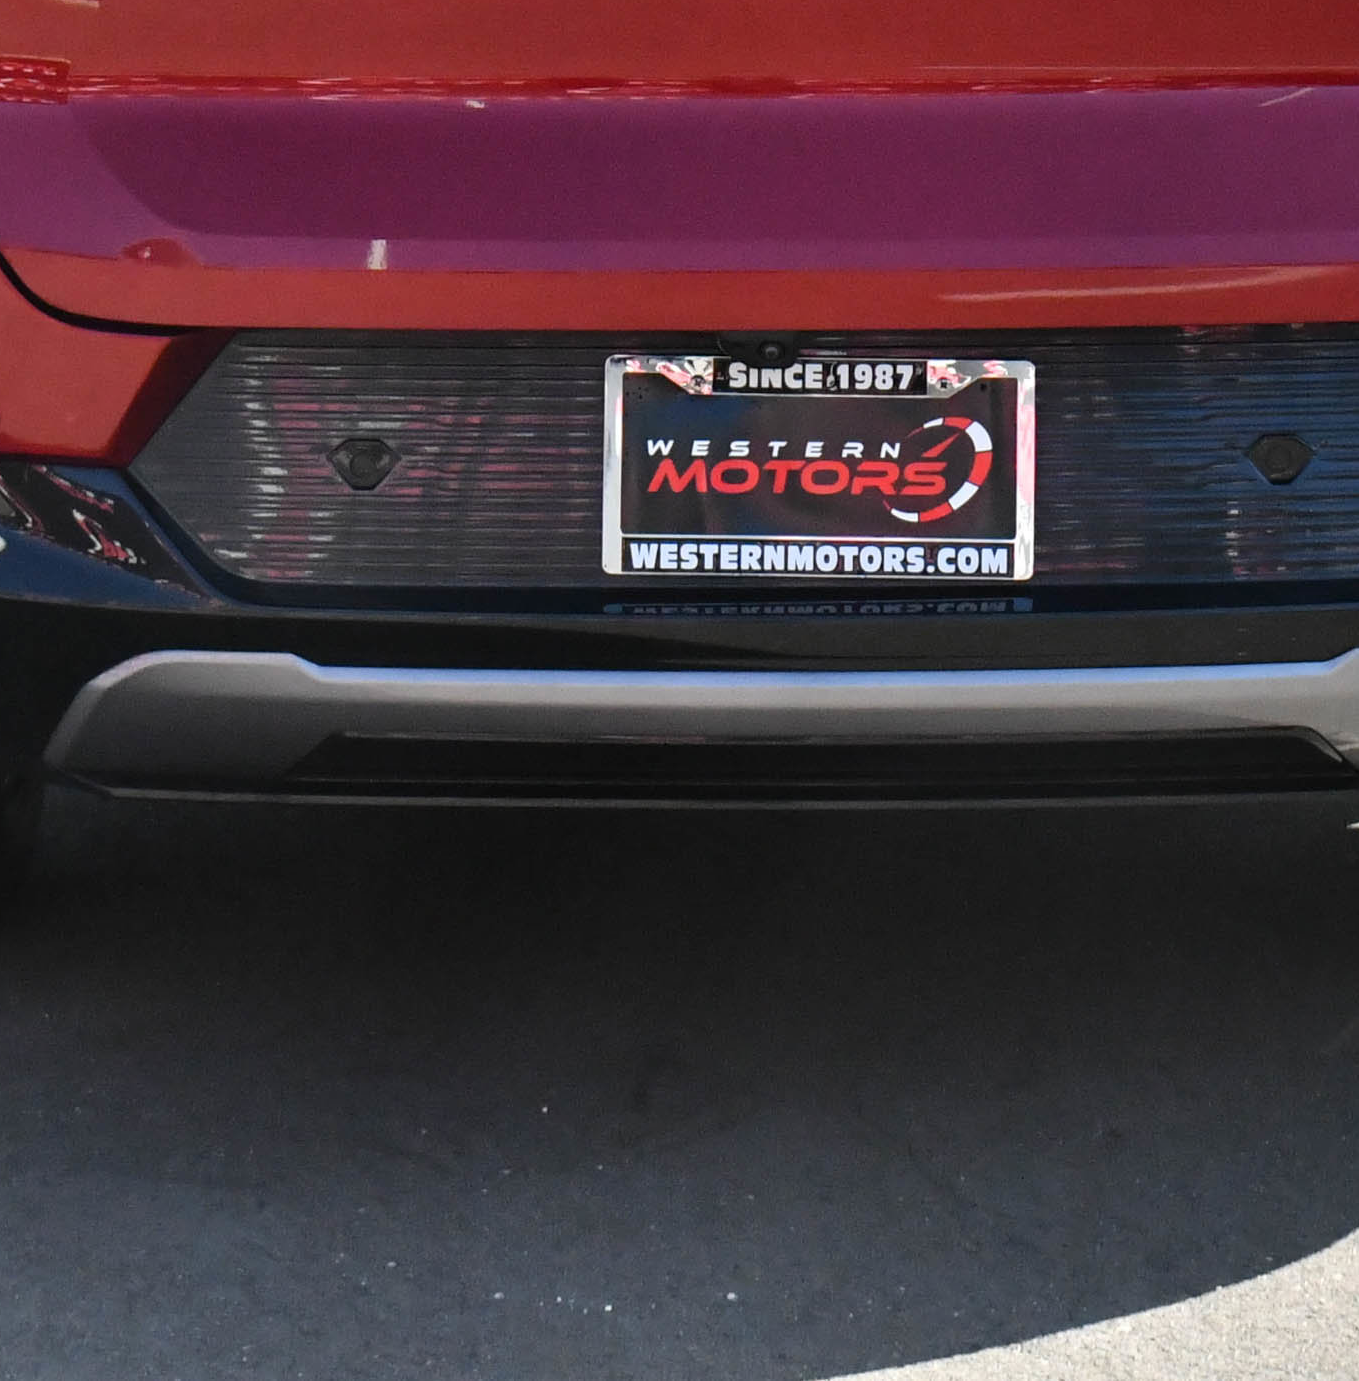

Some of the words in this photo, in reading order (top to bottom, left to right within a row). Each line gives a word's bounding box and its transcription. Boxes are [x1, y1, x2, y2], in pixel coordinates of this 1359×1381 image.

[836, 364, 914, 390] 1987
[647, 439, 901, 459] WESTERN
[648, 459, 948, 495] MOTORS
[630, 543, 1008, 575] WESTERNMOTORS.COM
